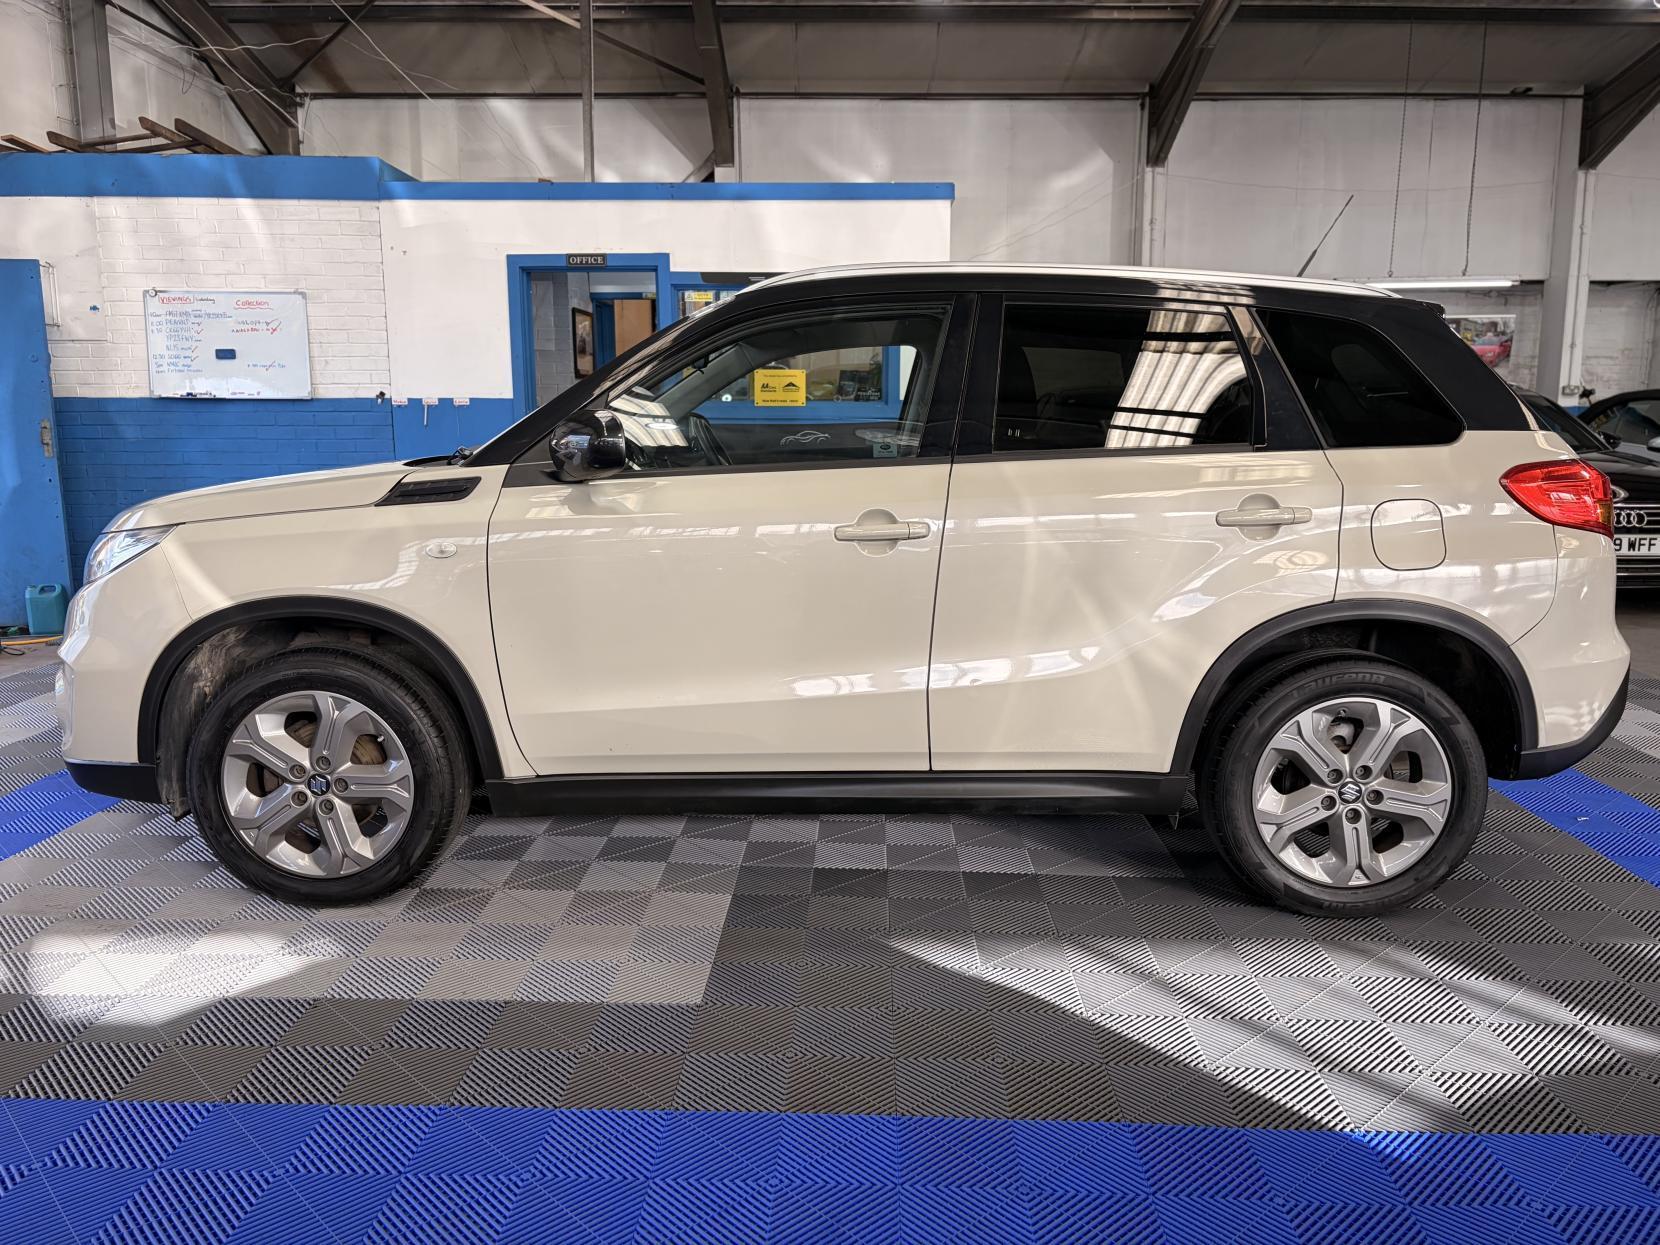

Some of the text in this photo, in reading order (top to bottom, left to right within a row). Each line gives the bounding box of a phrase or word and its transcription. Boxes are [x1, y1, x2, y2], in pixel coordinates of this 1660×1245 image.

[569, 256, 604, 264] OFFICE
[160, 295, 191, 303] VIEWINGS
[1627, 537, 1658, 552] WFF
